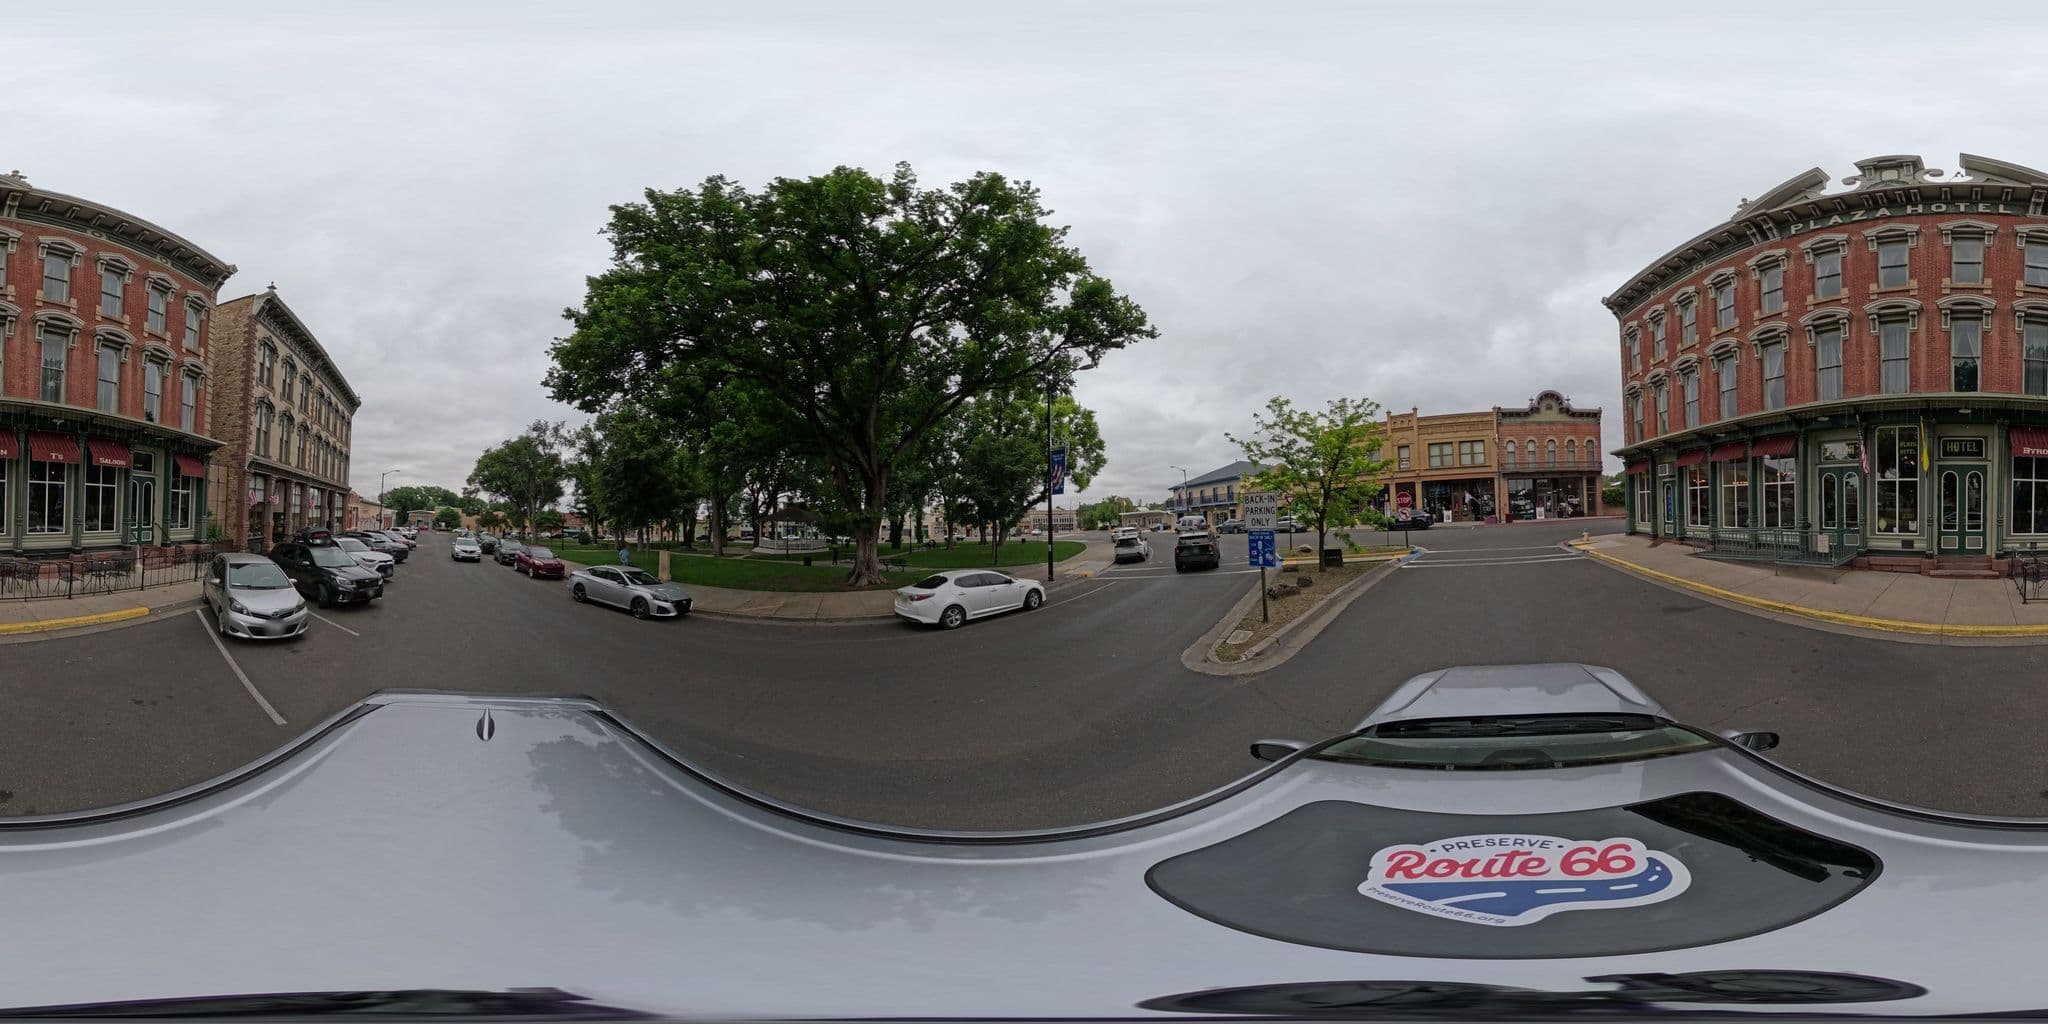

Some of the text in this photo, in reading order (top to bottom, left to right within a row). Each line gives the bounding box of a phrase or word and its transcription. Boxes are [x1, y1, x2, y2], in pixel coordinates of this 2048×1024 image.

[1791, 202, 2013, 235] PLAZA HOTEL
[1947, 441, 1979, 452] HOTEL
[1244, 494, 1275, 505] BACK-IN
[1245, 506, 1275, 515] PARKING
[1251, 517, 1270, 526] ONLY
[1441, 838, 1554, 853] PRESERVE
[1385, 843, 1637, 879] Route 66
[1366, 887, 1507, 924] PreserveRoute66.org
